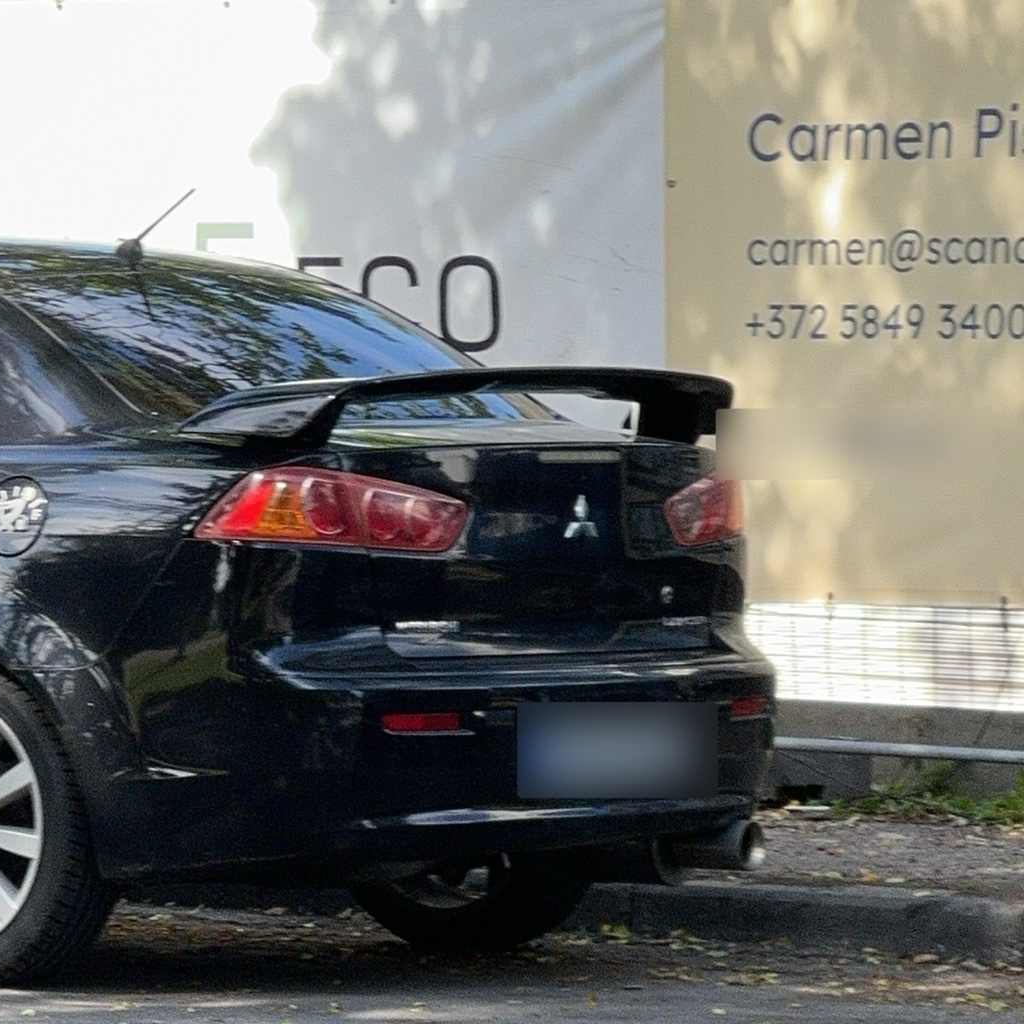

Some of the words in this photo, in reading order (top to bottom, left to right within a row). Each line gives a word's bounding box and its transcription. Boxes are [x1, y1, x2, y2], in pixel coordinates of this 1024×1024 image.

[747, 112, 953, 162] Carmen
[973, 102, 1024, 158] Pi
[744, 304, 827, 340] +372
[840, 303, 925, 340] 5849
[937, 303, 1024, 340] 3400
